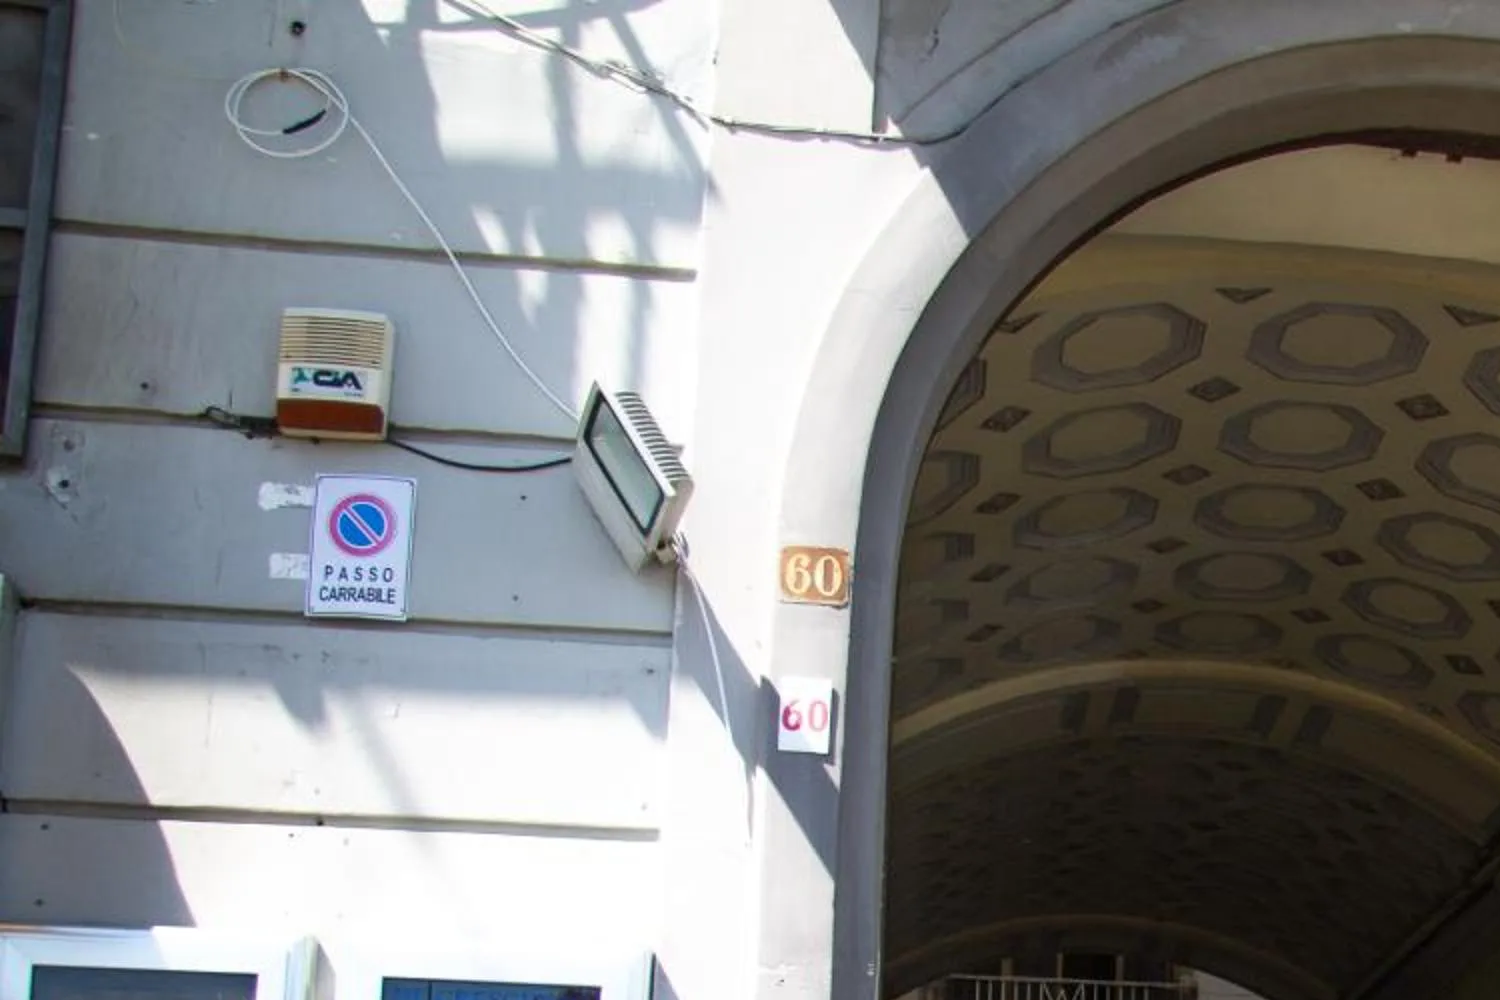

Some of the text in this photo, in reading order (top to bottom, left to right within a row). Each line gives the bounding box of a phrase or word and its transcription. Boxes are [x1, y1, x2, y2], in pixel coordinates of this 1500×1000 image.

[323, 564, 394, 583] PASSO
[785, 554, 842, 597] 60
[319, 586, 396, 605] CARRABILE
[782, 700, 829, 732] 60
